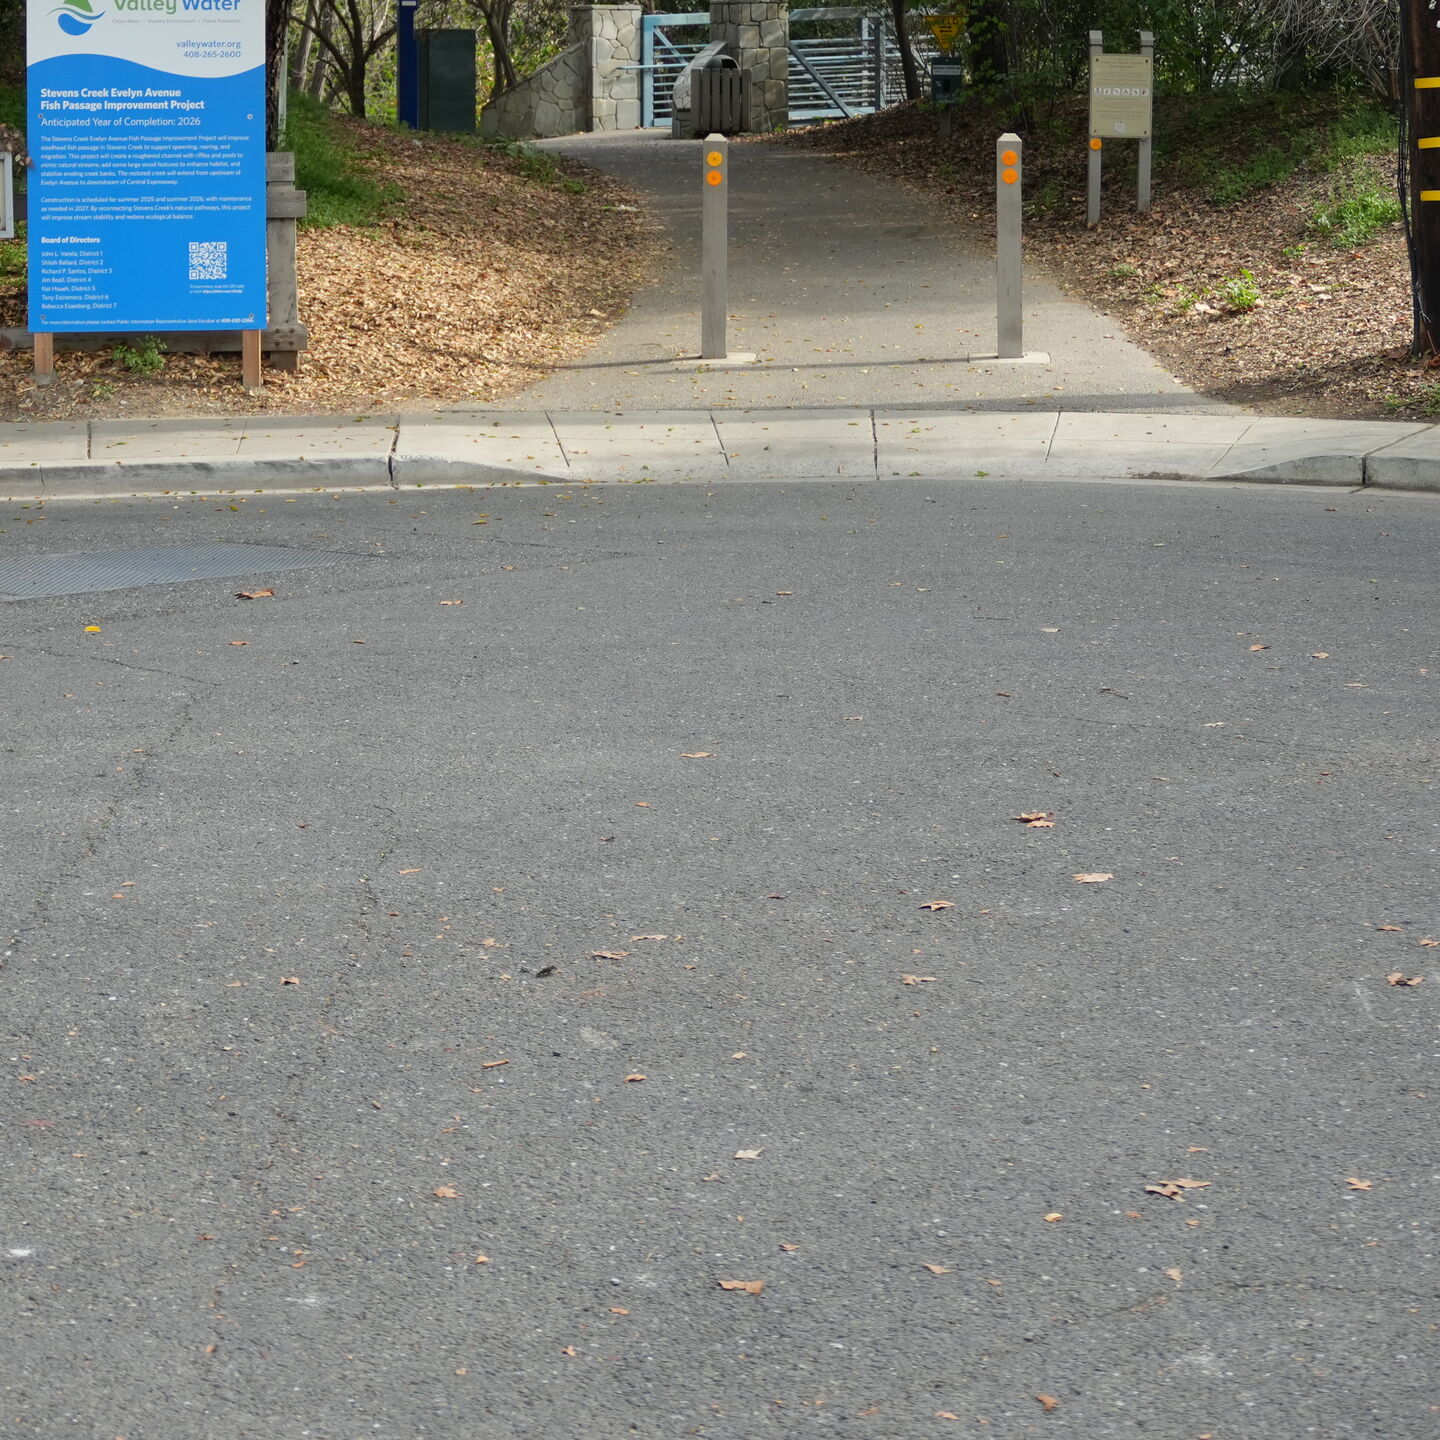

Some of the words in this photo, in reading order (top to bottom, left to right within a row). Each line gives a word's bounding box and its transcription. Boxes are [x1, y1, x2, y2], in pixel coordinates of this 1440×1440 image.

[176, 40, 241, 49] valleywater.org
[184, 50, 241, 58] 408-265-2600
[40, 88, 79, 98] Stevens
[81, 88, 108, 97] Creek
[111, 88, 143, 100] Evelyn
[145, 88, 181, 97] Avenue
[40, 101, 60, 110] Fish
[62, 101, 102, 112] Passage
[104, 100, 169, 111] Improvement
[171, 100, 204, 111] Project
[40, 117, 91, 127] Anticipated
[93, 117, 110, 126] Year
[112, 116, 122, 126] of
[124, 116, 176, 127] Completion:
[178, 117, 201, 126] 2026
